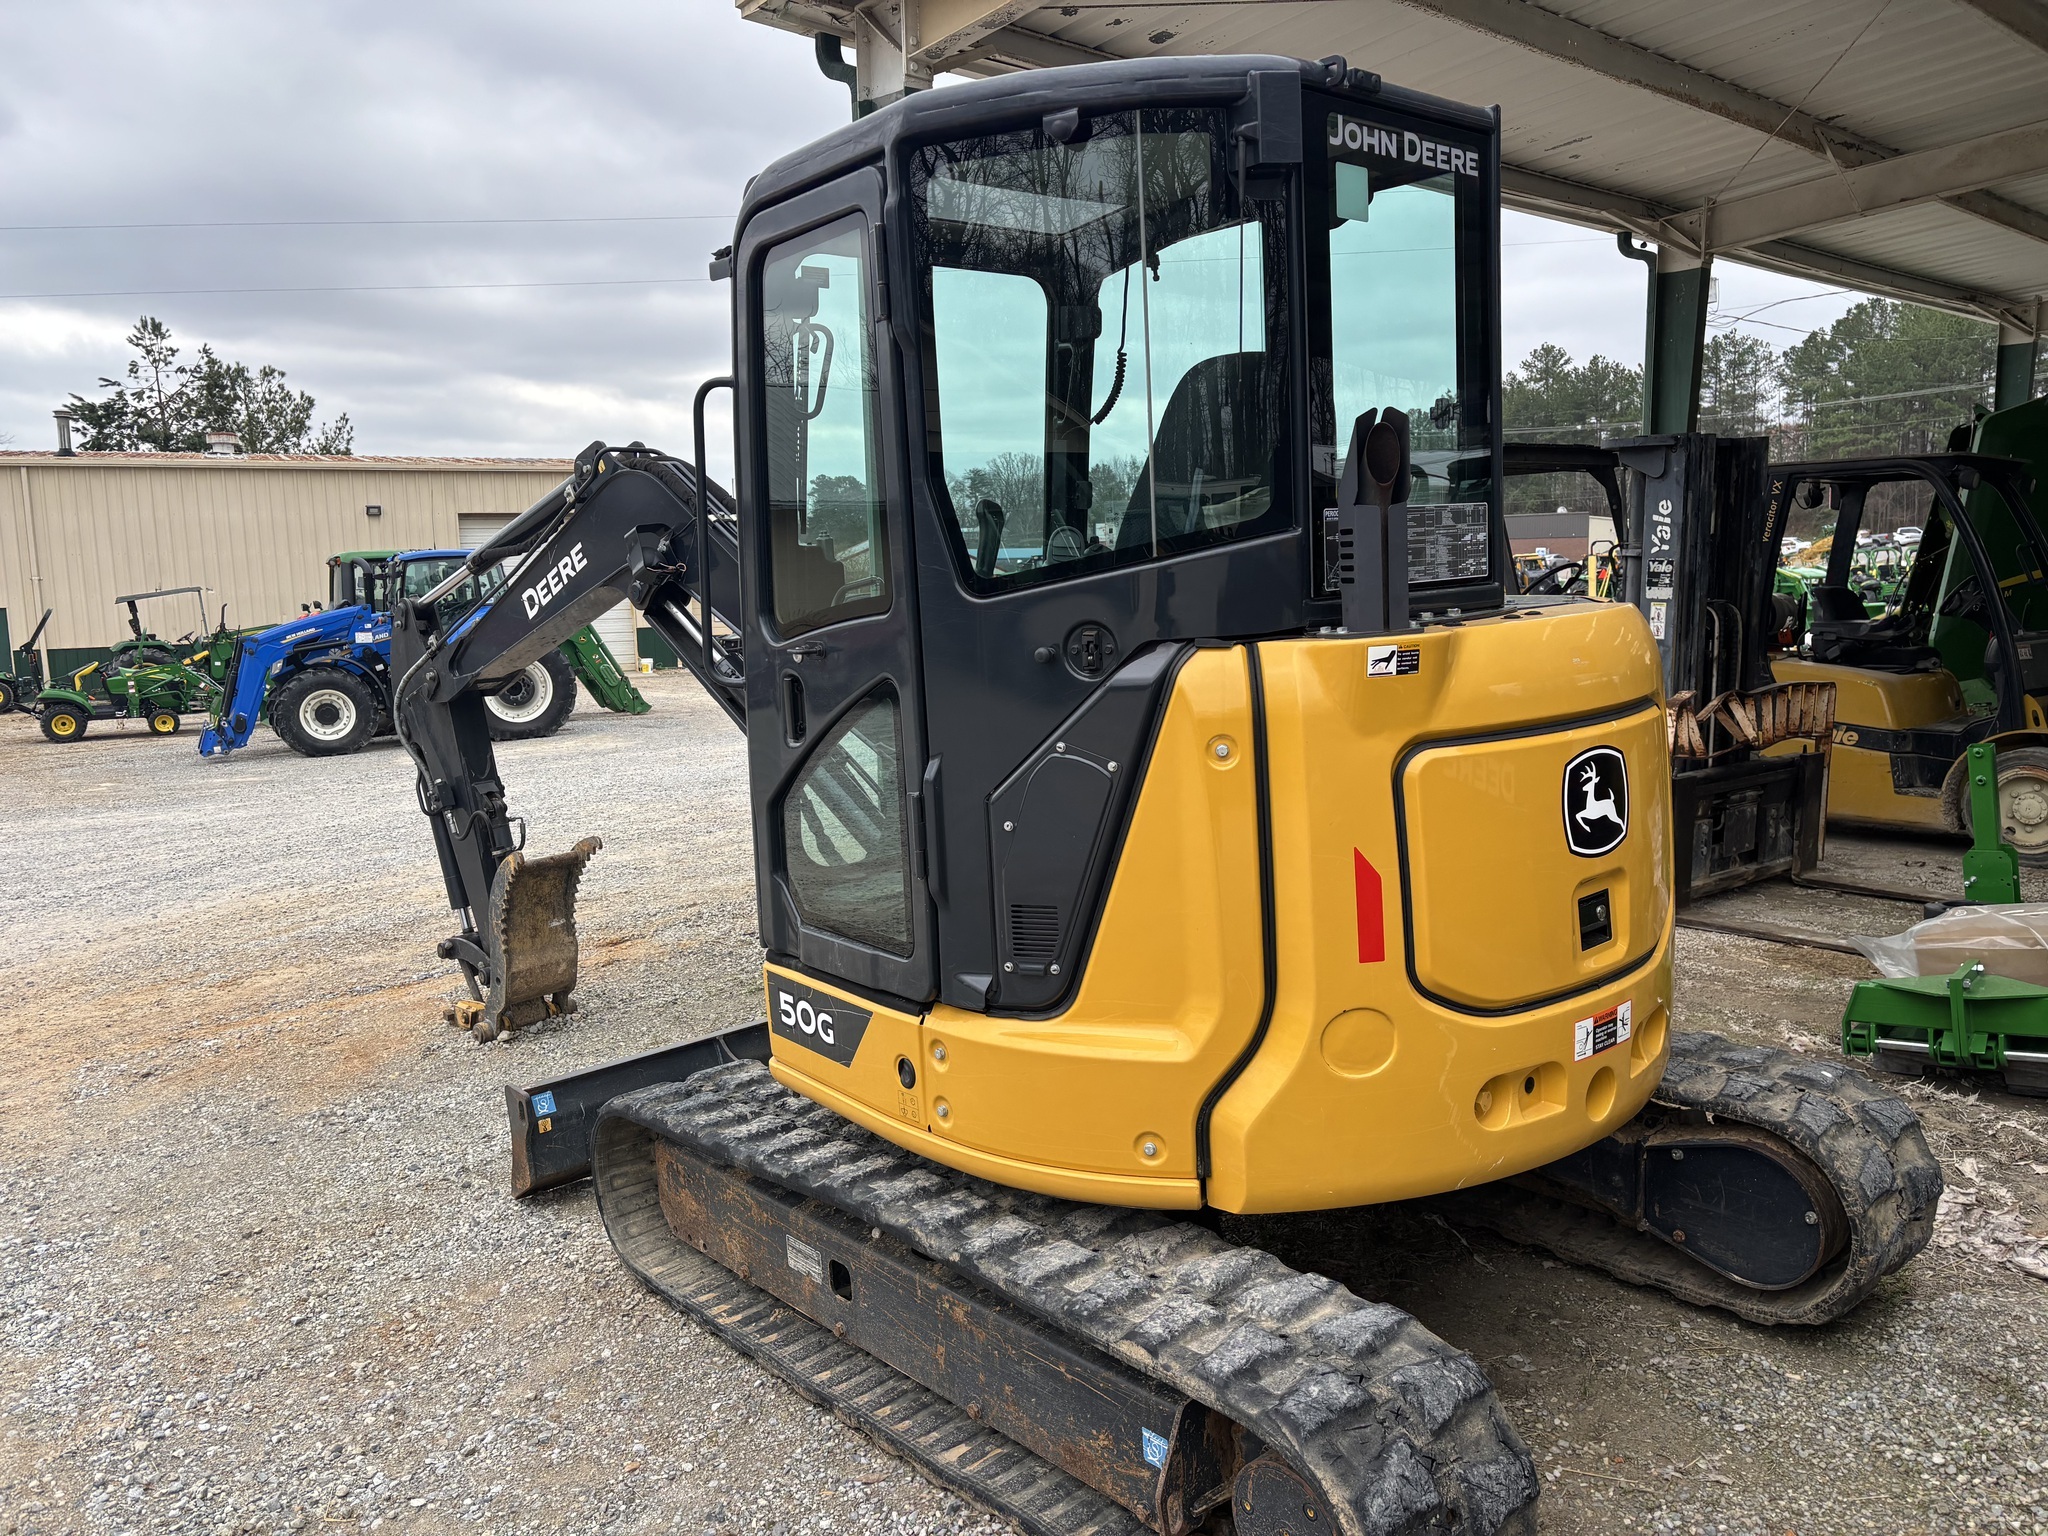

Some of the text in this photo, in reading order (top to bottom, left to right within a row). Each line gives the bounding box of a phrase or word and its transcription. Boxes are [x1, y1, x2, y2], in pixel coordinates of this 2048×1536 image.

[1329, 114, 1479, 177] JOHN DEERE
[1771, 480, 1783, 495] VX
[1651, 499, 1673, 554] Yale
[521, 541, 588, 620] DEERE
[1649, 560, 1673, 572] Yale
[1832, 725, 1859, 746] le
[779, 991, 834, 1045] 50G
